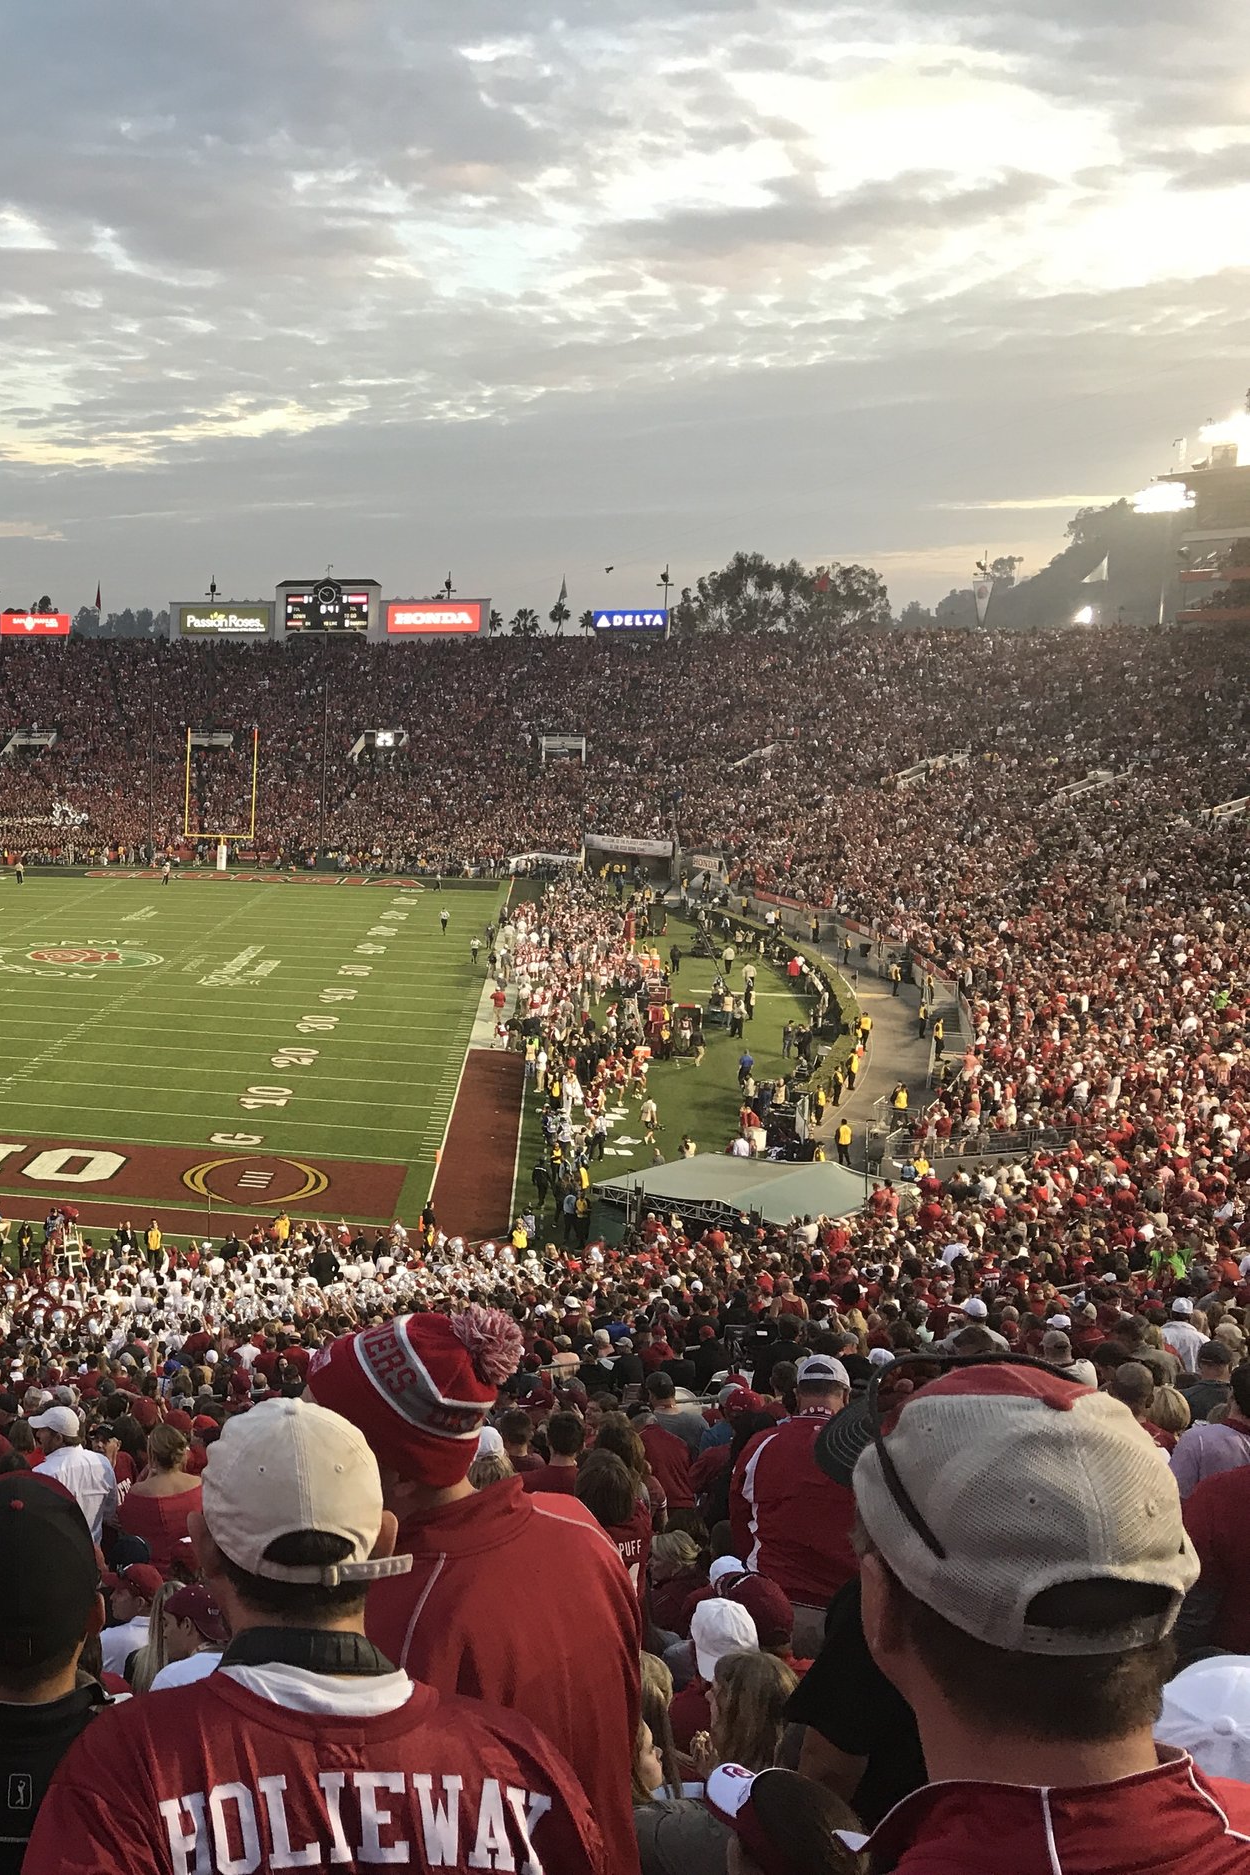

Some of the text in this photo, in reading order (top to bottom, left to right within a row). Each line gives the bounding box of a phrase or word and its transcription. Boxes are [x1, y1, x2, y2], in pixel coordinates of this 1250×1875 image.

[186, 615, 228, 628] Passion
[394, 612, 473, 625] HONDA
[612, 614, 664, 627] DELTA
[693, 856, 718, 870] HONDA
[84, 870, 426, 889] GEORGIA
[337, 964, 373, 977] 50
[295, 1015, 340, 1031] 30
[270, 1047, 320, 1067] 20
[240, 1086, 293, 1107] 10
[210, 1132, 264, 1146] G
[618, 1539, 642, 1557] PUFF
[159, 1771, 552, 1875] HOLIEWAY
